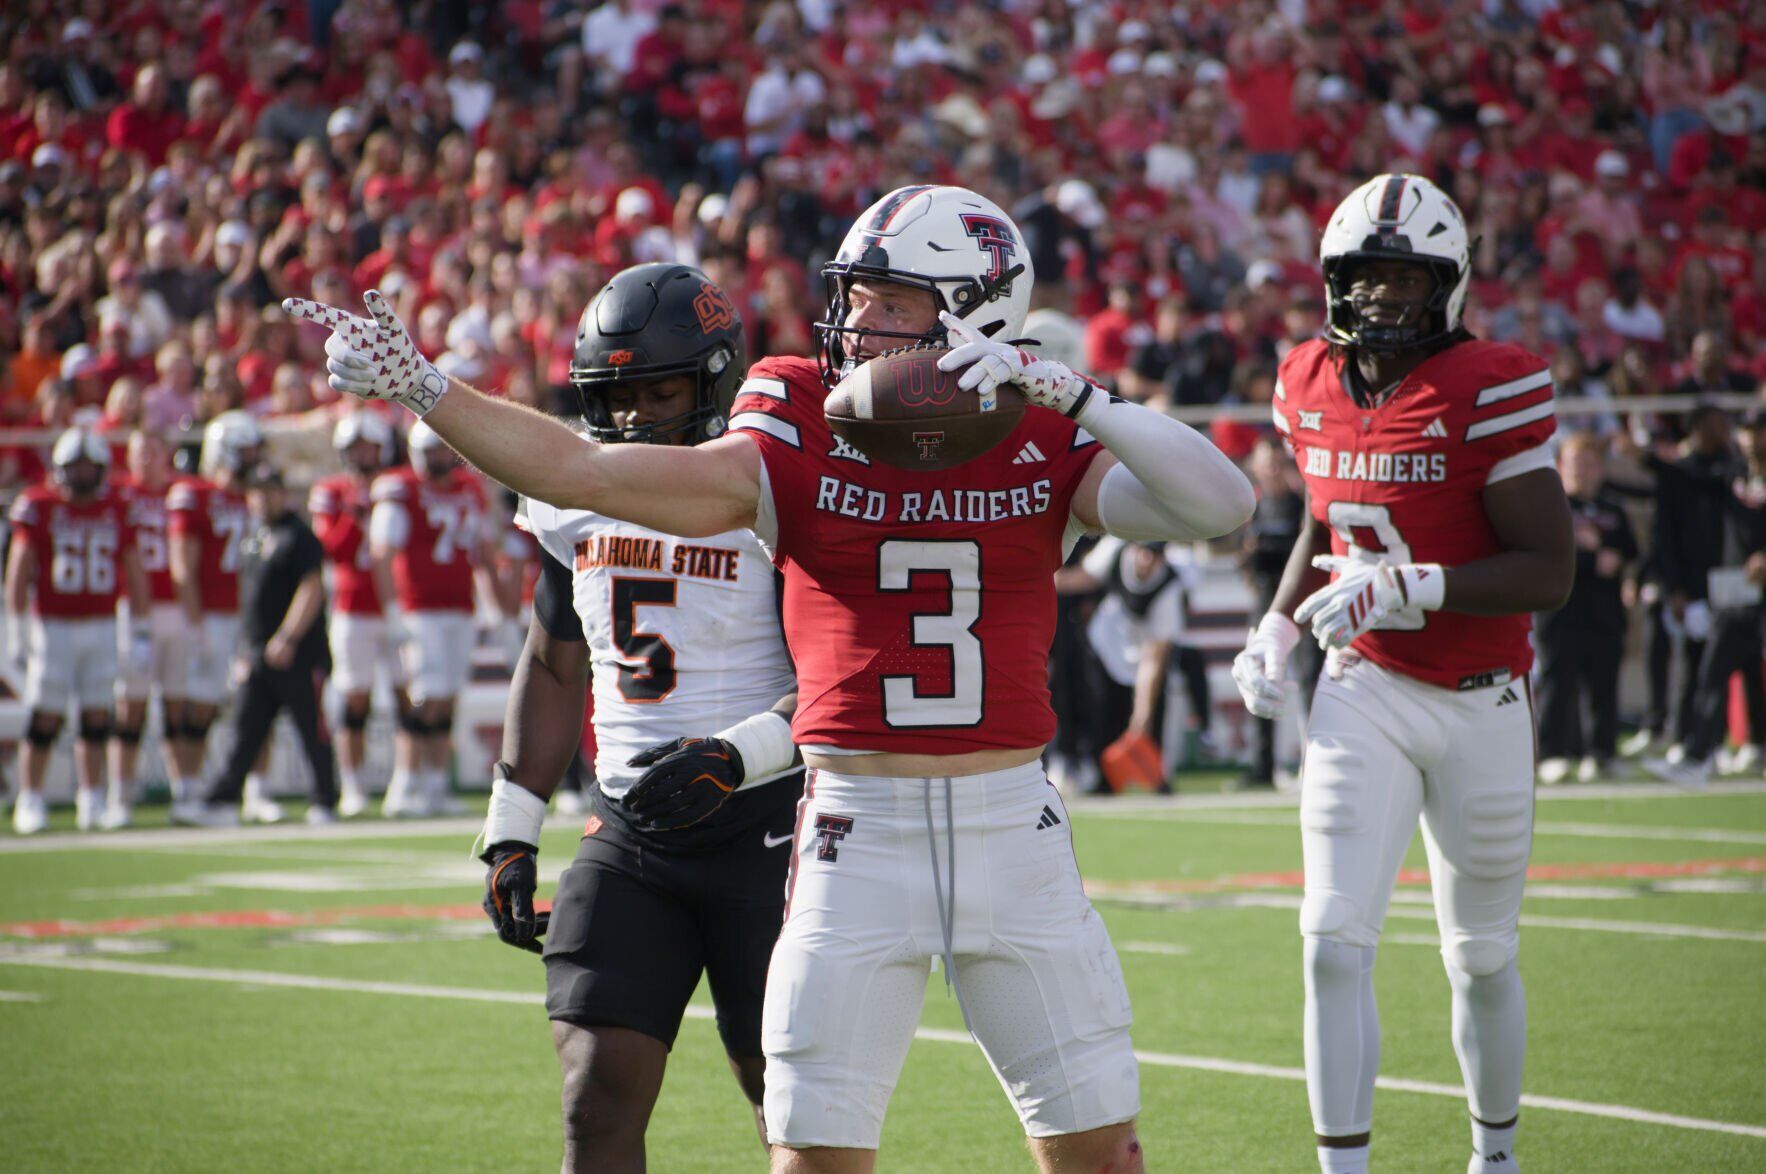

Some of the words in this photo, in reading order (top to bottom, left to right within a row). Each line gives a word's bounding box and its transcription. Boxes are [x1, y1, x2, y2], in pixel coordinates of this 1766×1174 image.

[693, 282, 733, 334] OS
[890, 358, 960, 407] W
[1336, 450, 1447, 482] RAIDERS
[815, 475, 886, 523] RED
[899, 478, 1052, 523] RAIDERS
[52, 530, 118, 594] 66
[574, 535, 665, 573] OKLAHOMA
[671, 544, 740, 582] STATE
[611, 576, 678, 704] 5
[876, 538, 986, 730] 3
